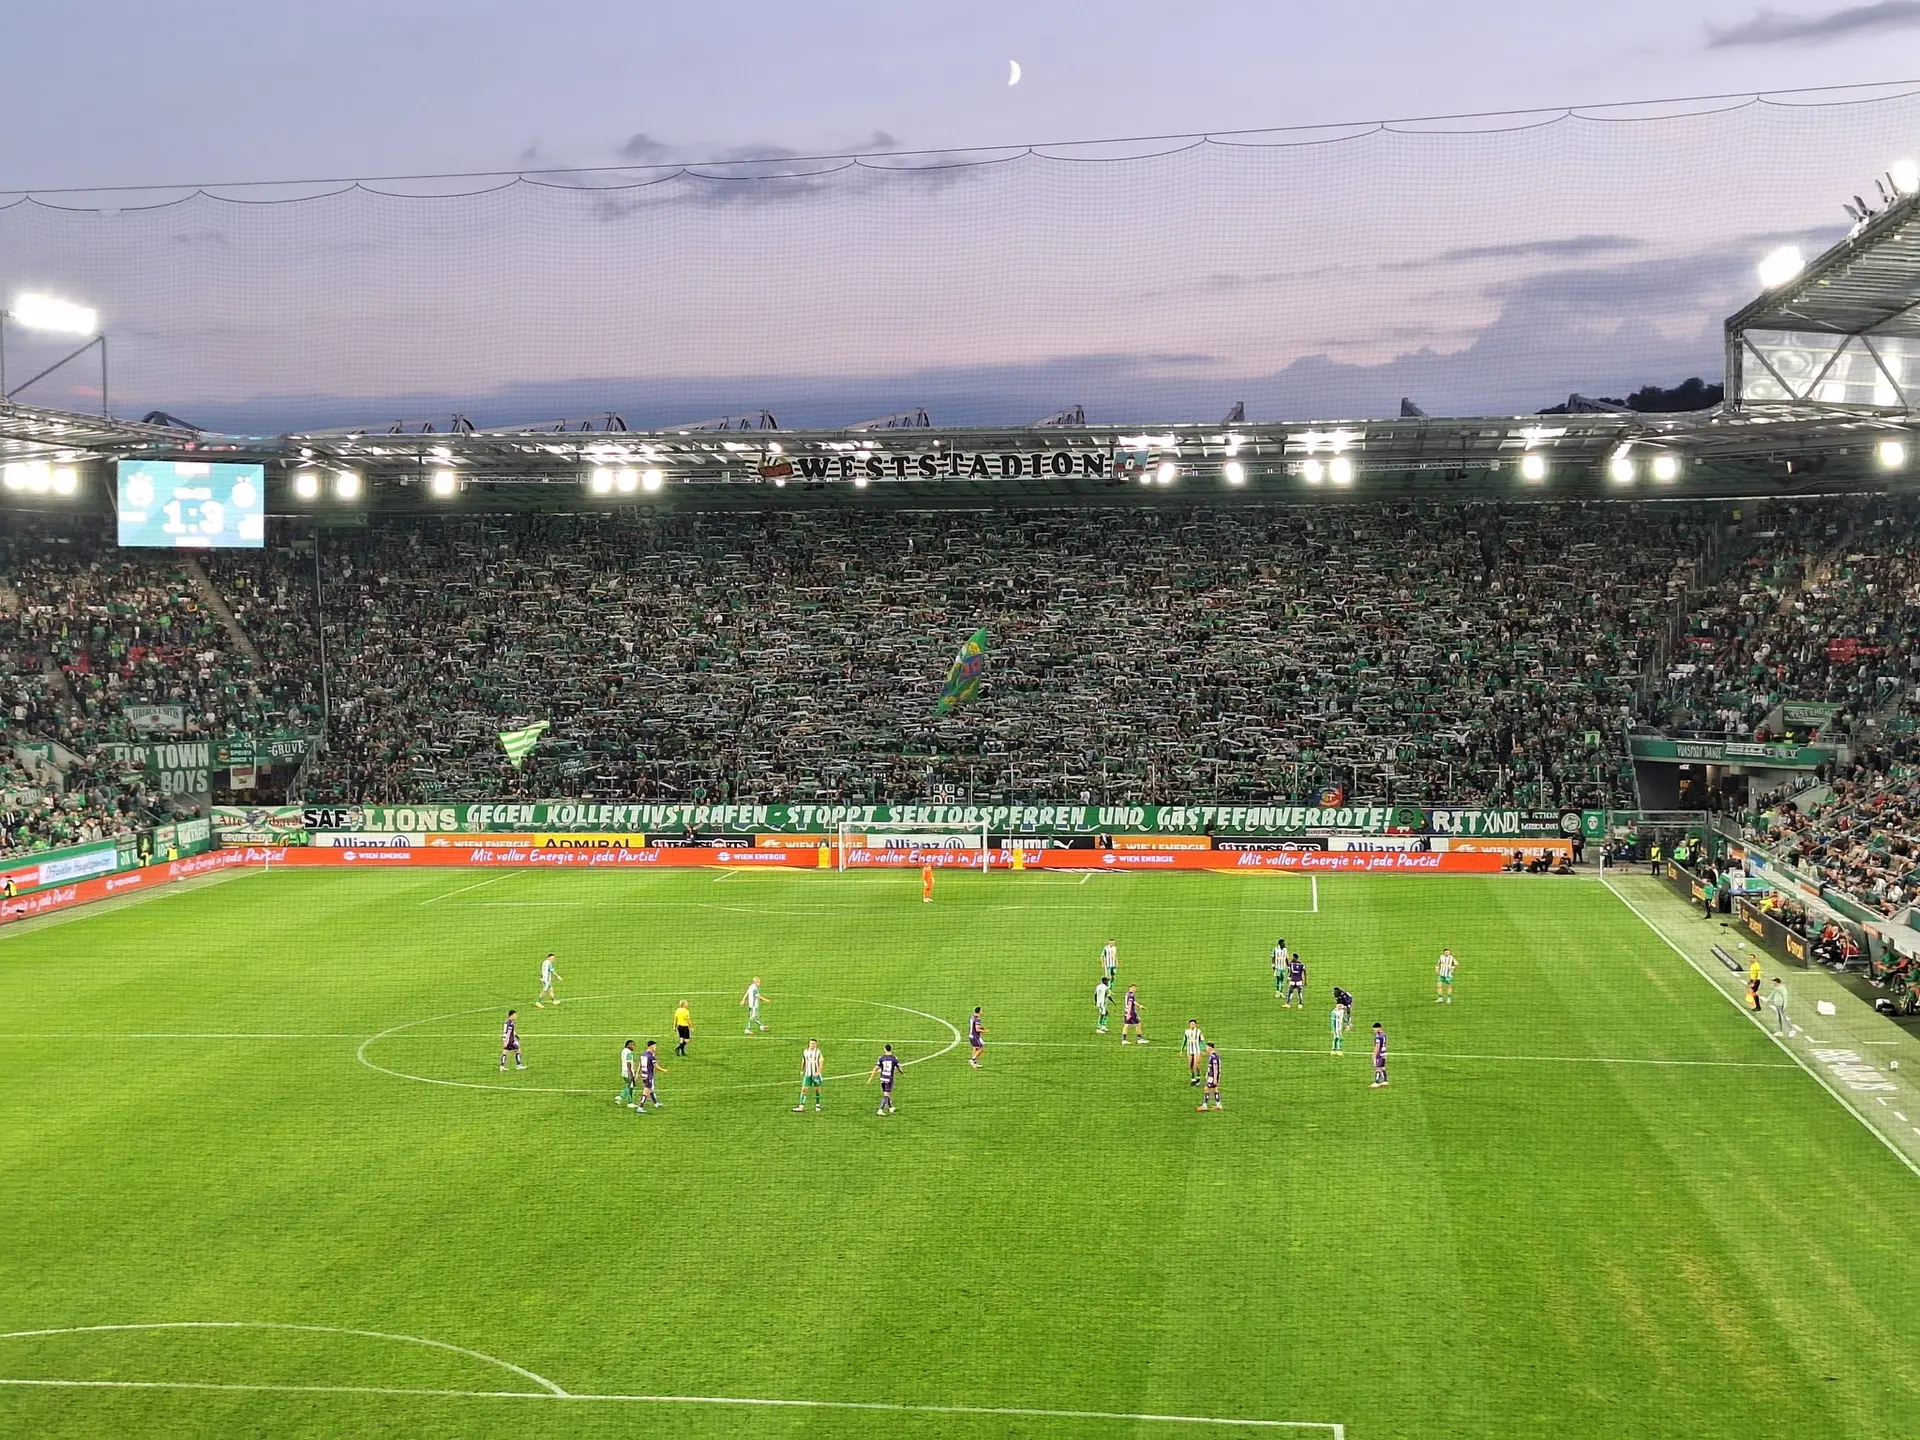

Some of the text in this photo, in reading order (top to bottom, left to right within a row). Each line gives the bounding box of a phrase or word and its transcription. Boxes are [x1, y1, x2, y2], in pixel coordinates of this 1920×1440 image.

[797, 454, 1106, 480] WESTSTADION
[155, 744, 210, 769] TOWN
[160, 770, 208, 795] BOYS
[303, 809, 348, 828] SAF
[363, 808, 458, 831] LIONS
[467, 804, 536, 823] GEGEN
[547, 804, 769, 824] KOLLEKTIVSTRAFEN
[787, 804, 878, 824] STOPPT
[888, 805, 1087, 826] SEKTORSPERREN
[1098, 806, 1145, 825] UND
[333, 837, 386, 847] Allianz
[885, 838, 939, 848] Allianz
[1347, 842, 1405, 852] Allianz
[470, 848, 660, 865] Mit voller Energie in jede Partie!
[848, 850, 871, 863] Mit
[875, 849, 905, 862] voller
[908, 849, 954, 865] Energie
[958, 850, 969, 862] in
[1237, 852, 1442, 869] Mit voller Energie in jede Partie!
